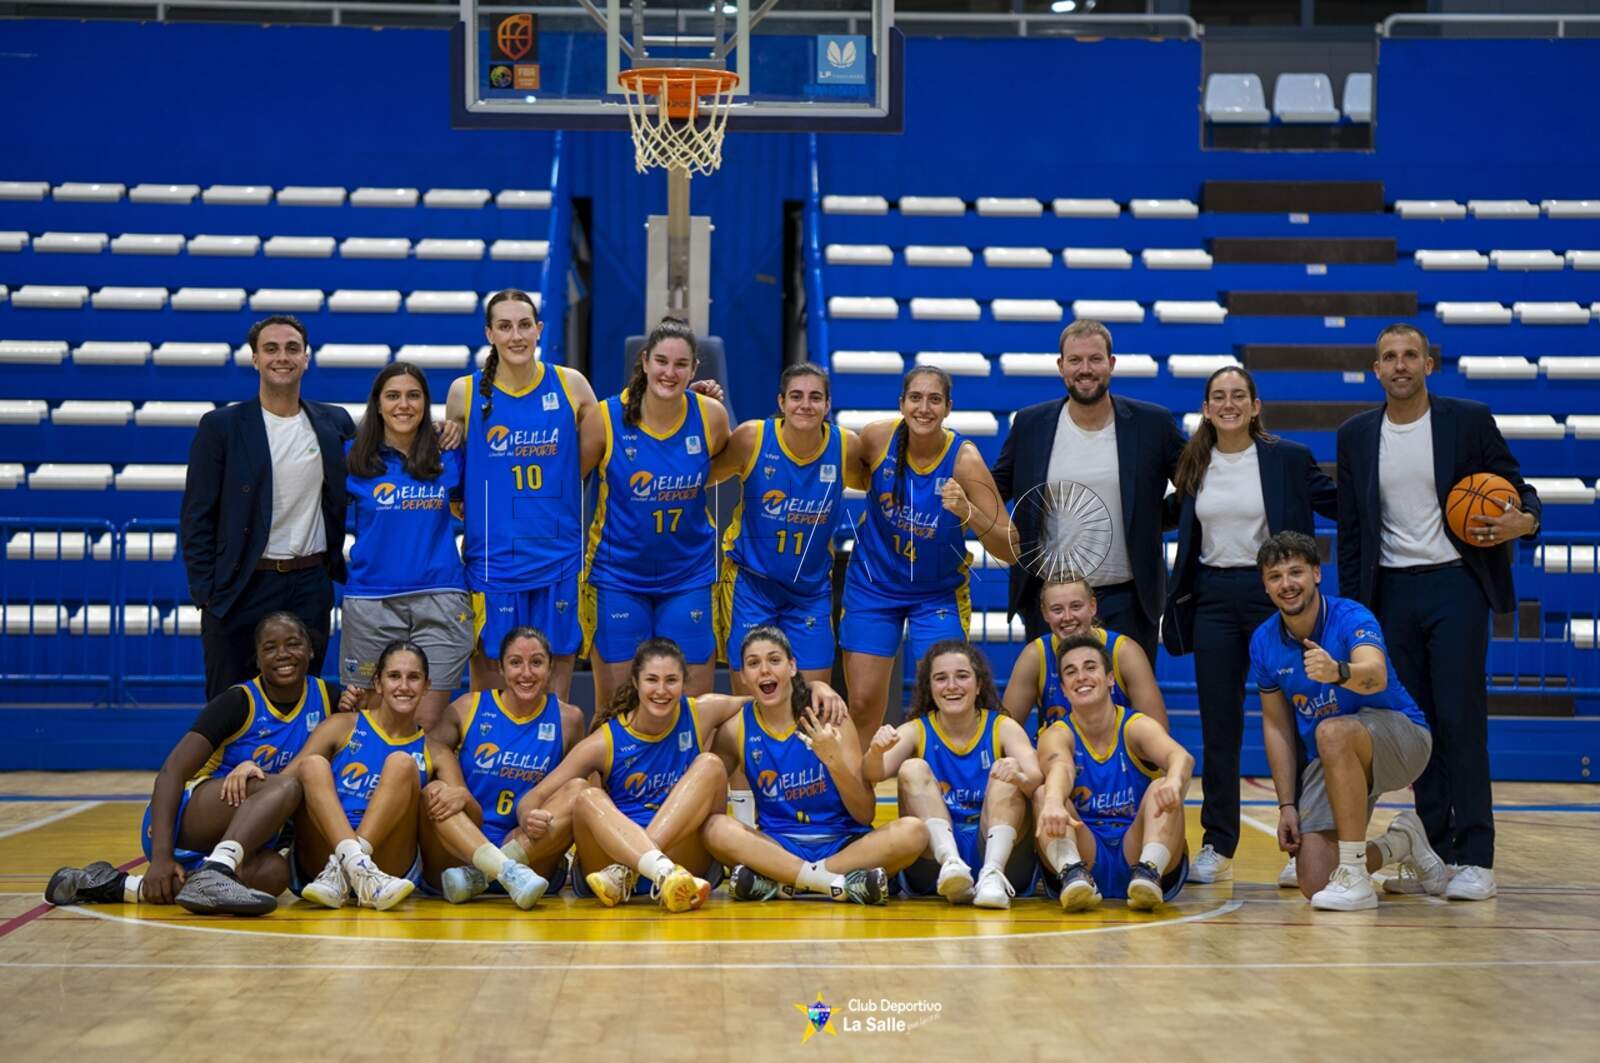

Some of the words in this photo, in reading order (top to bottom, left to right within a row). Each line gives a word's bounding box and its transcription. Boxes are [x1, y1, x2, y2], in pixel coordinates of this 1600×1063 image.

[511, 464, 543, 491] 10
[652, 508, 684, 534] 17
[776, 529, 805, 556] 11
[892, 534, 917, 563] 14
[496, 790, 515, 815] 6
